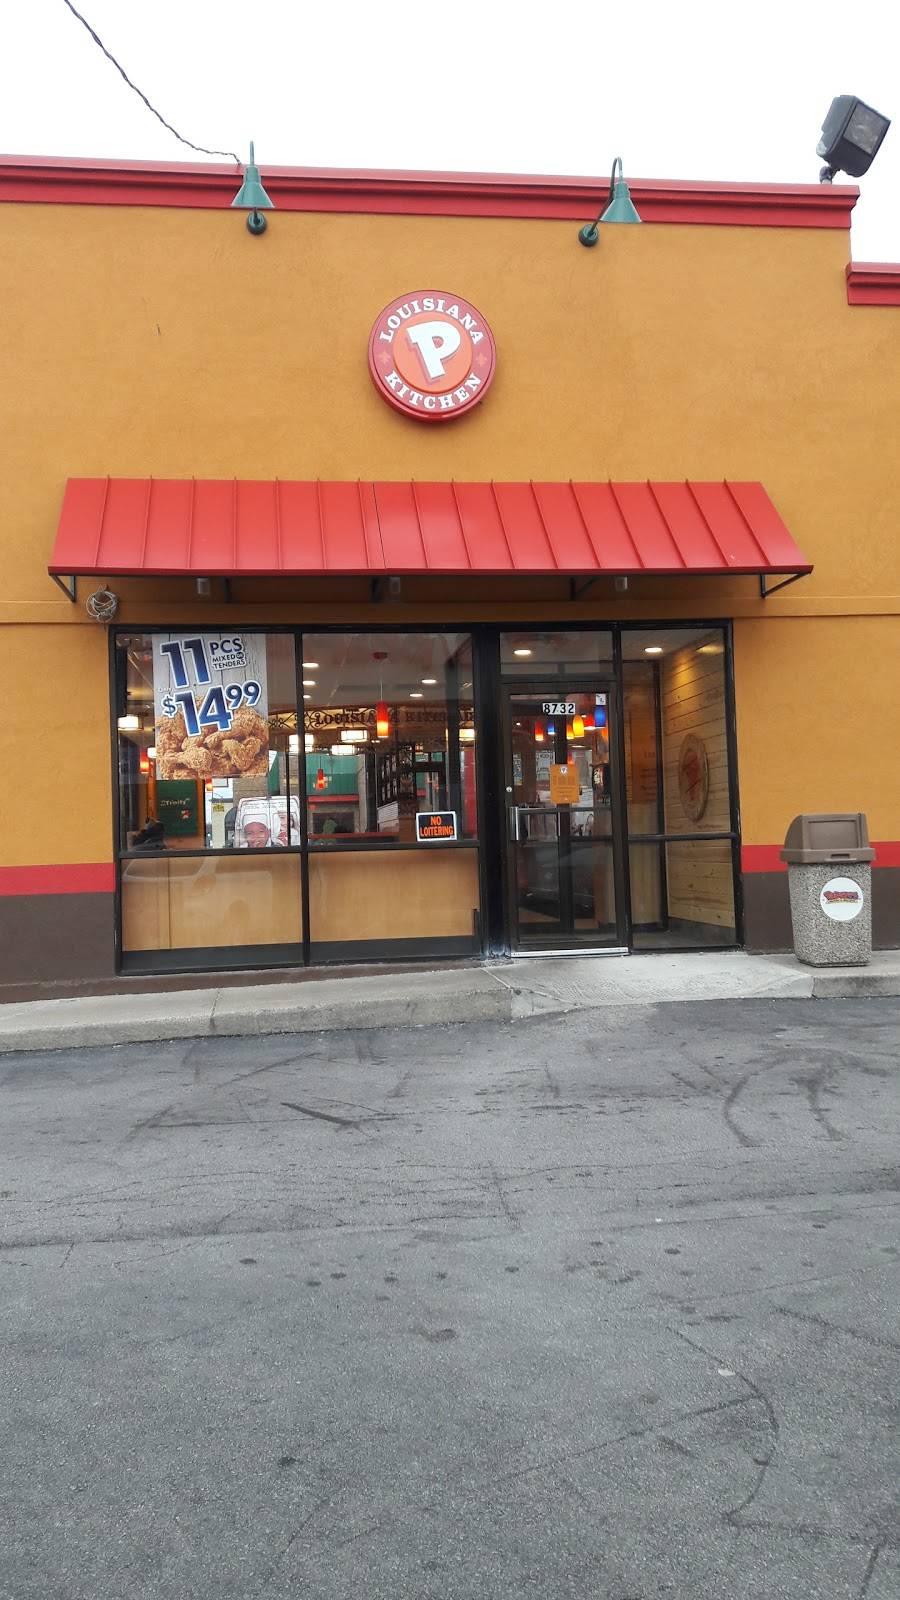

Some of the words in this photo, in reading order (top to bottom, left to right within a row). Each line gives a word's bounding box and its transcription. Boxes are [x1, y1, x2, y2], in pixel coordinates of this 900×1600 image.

[379, 297, 484, 345] LOUISIANA
[406, 321, 461, 379] P
[384, 370, 481, 409] KITCHEN
[209, 638, 243, 656] PCS
[161, 638, 210, 688] 11
[212, 653, 236, 663] MIXED
[213, 658, 246, 669] TENDERS
[544, 703, 574, 714] 8732
[430, 815, 442, 826] NO
[420, 825, 454, 837] LOITERING
